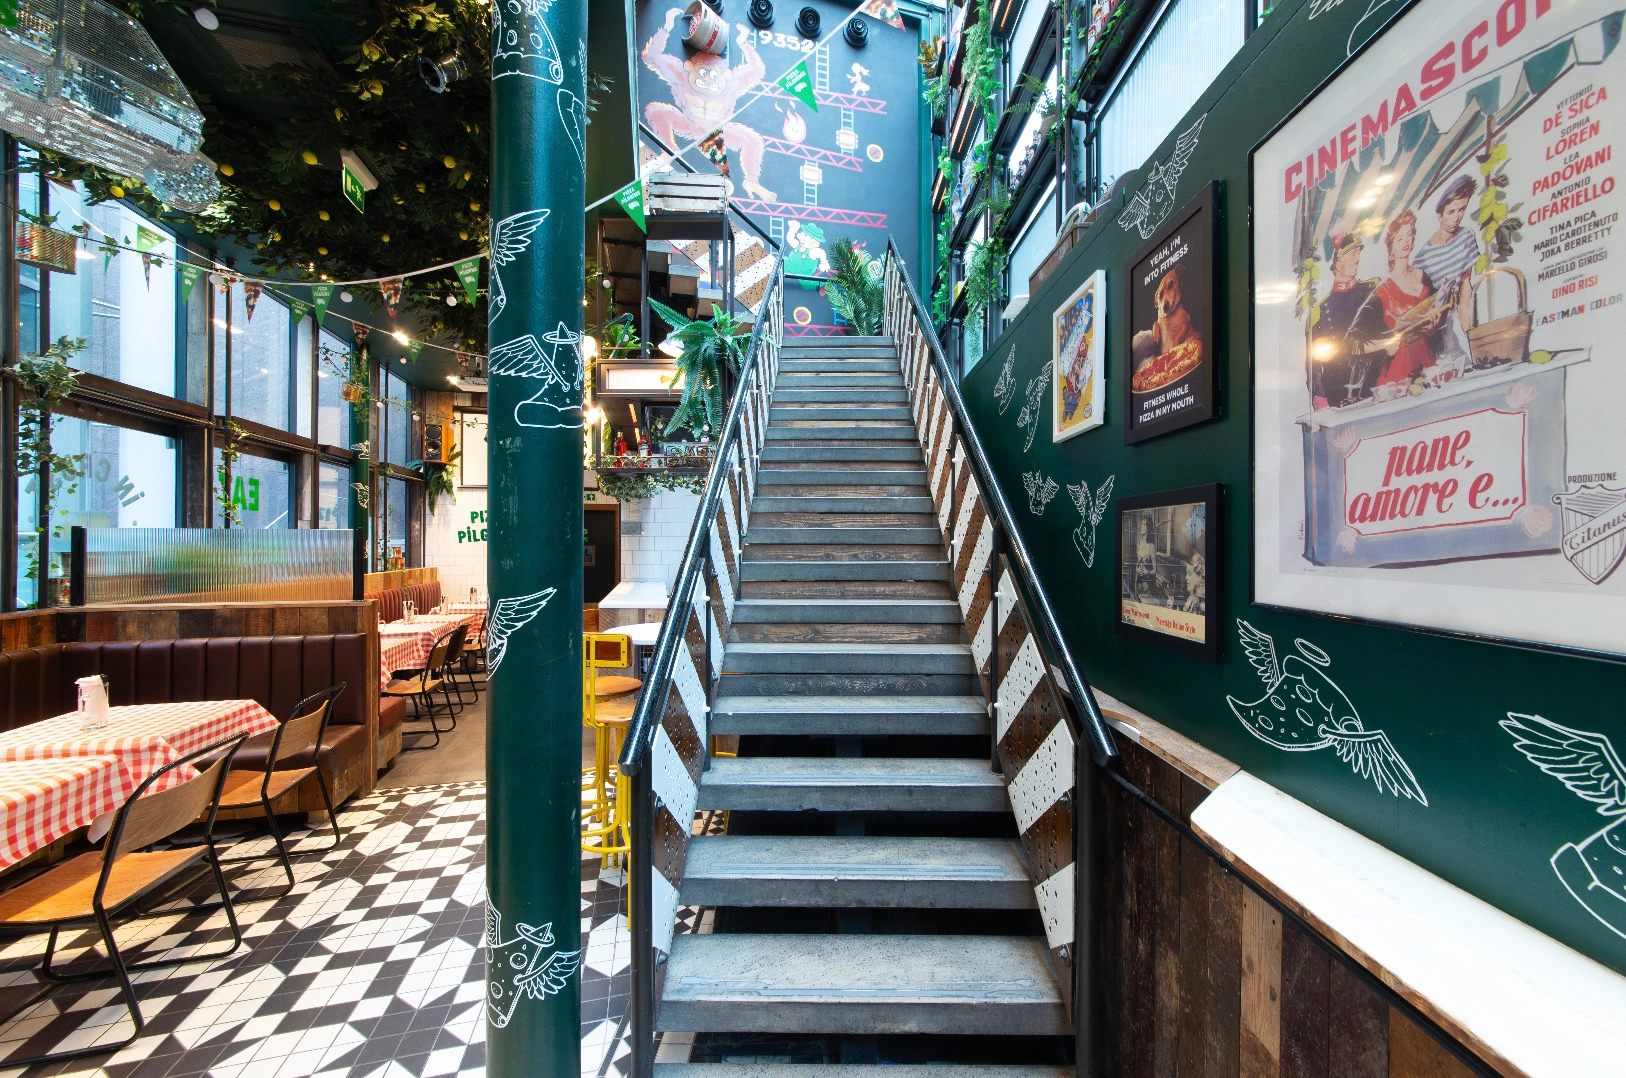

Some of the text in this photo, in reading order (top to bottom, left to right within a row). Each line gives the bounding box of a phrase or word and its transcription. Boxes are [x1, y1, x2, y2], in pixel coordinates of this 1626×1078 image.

[1542, 85, 1608, 135] DE SICA
[1556, 83, 1593, 110] VITTORIO
[1545, 119, 1601, 162] LOREN
[1560, 115, 1590, 138] SOPHIA
[1532, 144, 1612, 196] PADOVANI
[1563, 151, 1580, 165] LEA
[1527, 176, 1615, 226] CIFARIELLO
[1550, 175, 1591, 201] ANTONIO
[1533, 212, 1618, 253] MARIO CAROTENUTO
[1549, 210, 1597, 235] TINA PICA
[1150, 235, 1181, 267] YEAH, I'M
[1540, 245, 1561, 262] JOKA
[1564, 225, 1612, 252] BERRETTY
[1144, 243, 1188, 286] INTO FITNESS
[1538, 261, 1576, 282] MARCELLO
[1578, 250, 1608, 268] GIROSI
[1551, 282, 1576, 300] DINO
[1578, 275, 1599, 291] RISI
[1535, 293, 1623, 327] EASTMAN COLOR
[1143, 383, 1189, 410] FITNESS WHOLE
[1139, 411, 1154, 423] PIZZA
[1155, 407, 1161, 418] IN
[1381, 429, 1474, 487] pane,
[1567, 472, 1617, 484] PRODUZIONE
[1348, 472, 1519, 524] amore e...
